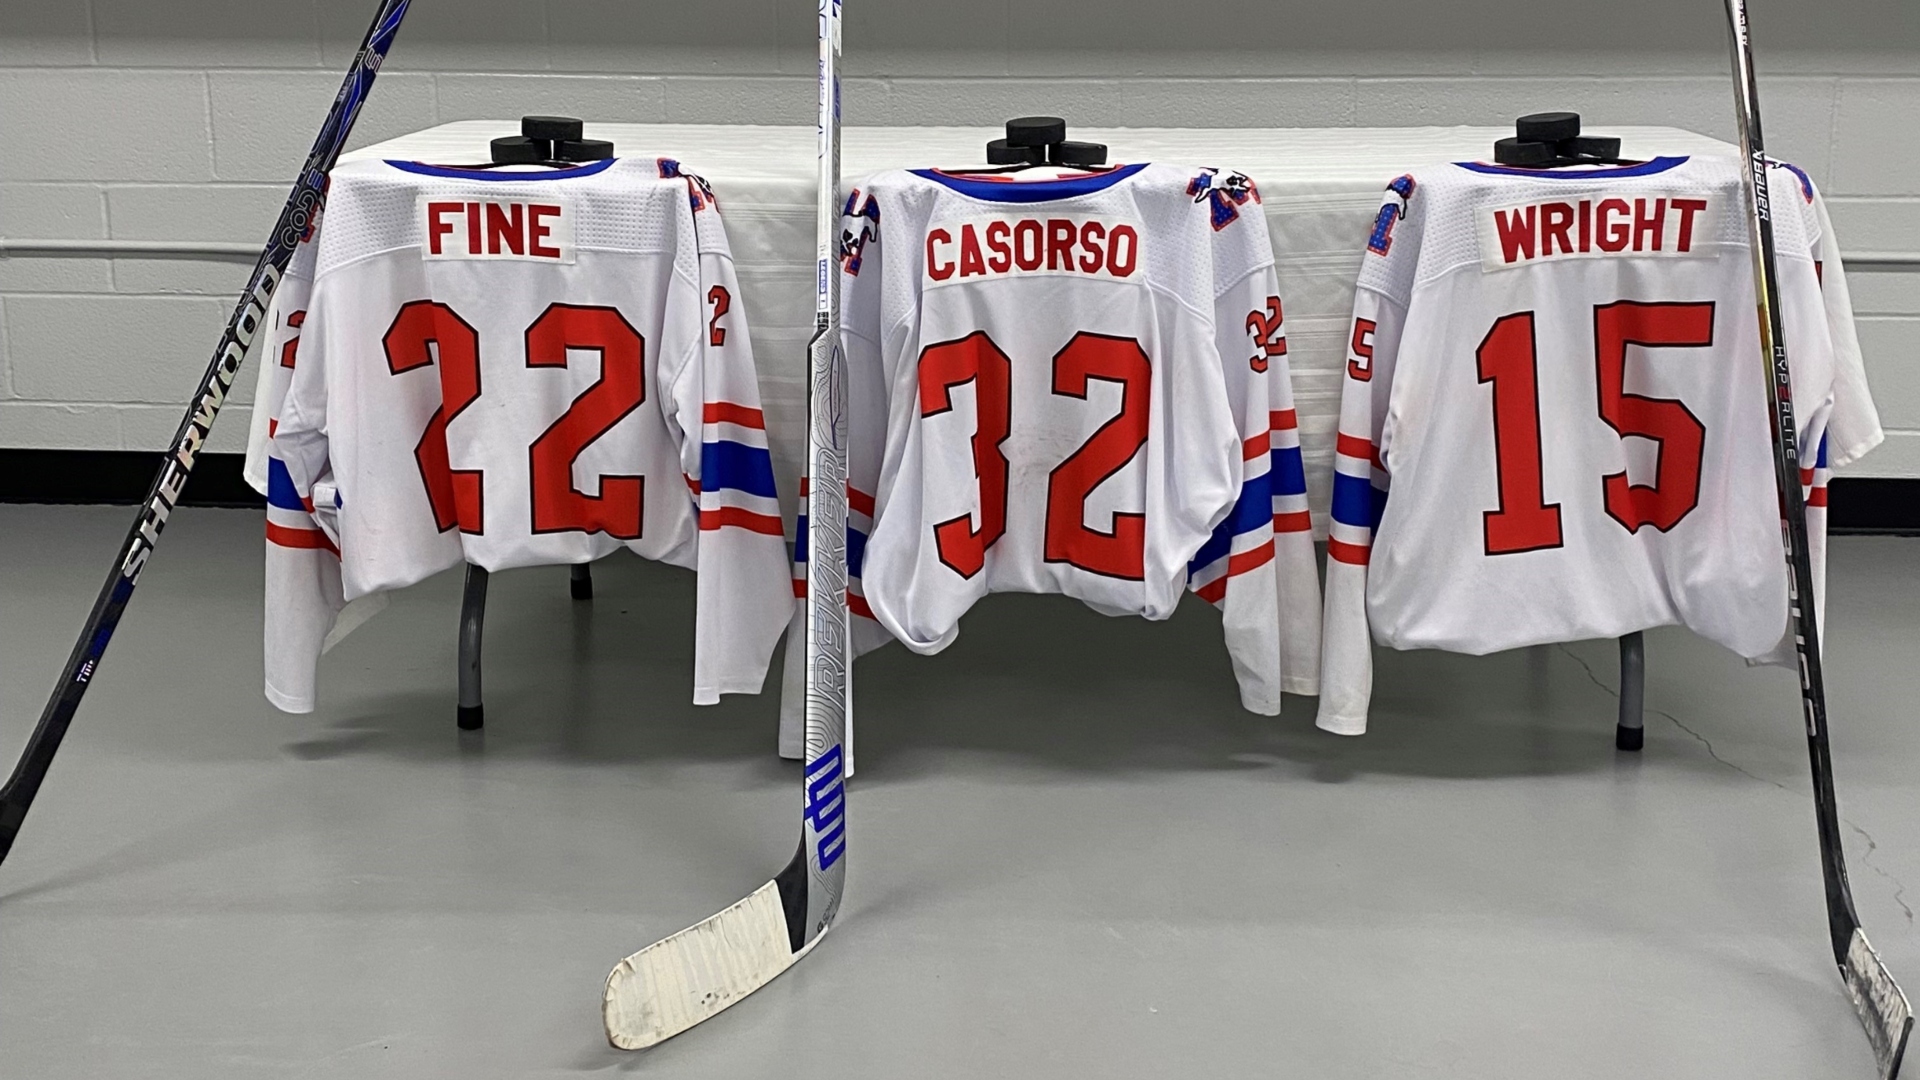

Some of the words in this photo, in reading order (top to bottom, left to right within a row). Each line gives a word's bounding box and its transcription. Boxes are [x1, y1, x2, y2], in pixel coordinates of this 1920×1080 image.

[281, 168, 324, 250] CODE
[428, 202, 561, 258] FINE
[1494, 198, 1707, 264] WRIGHT
[926, 219, 1139, 281] CASORSO
[708, 285, 731, 346] 2
[1246, 295, 1287, 374] 32
[1348, 317, 1376, 382] 5
[119, 261, 281, 585] SHERWOOD
[382, 299, 645, 540] 22
[917, 330, 1153, 580] 32
[1476, 300, 1715, 556] 15
[814, 448, 846, 711] REKKER
